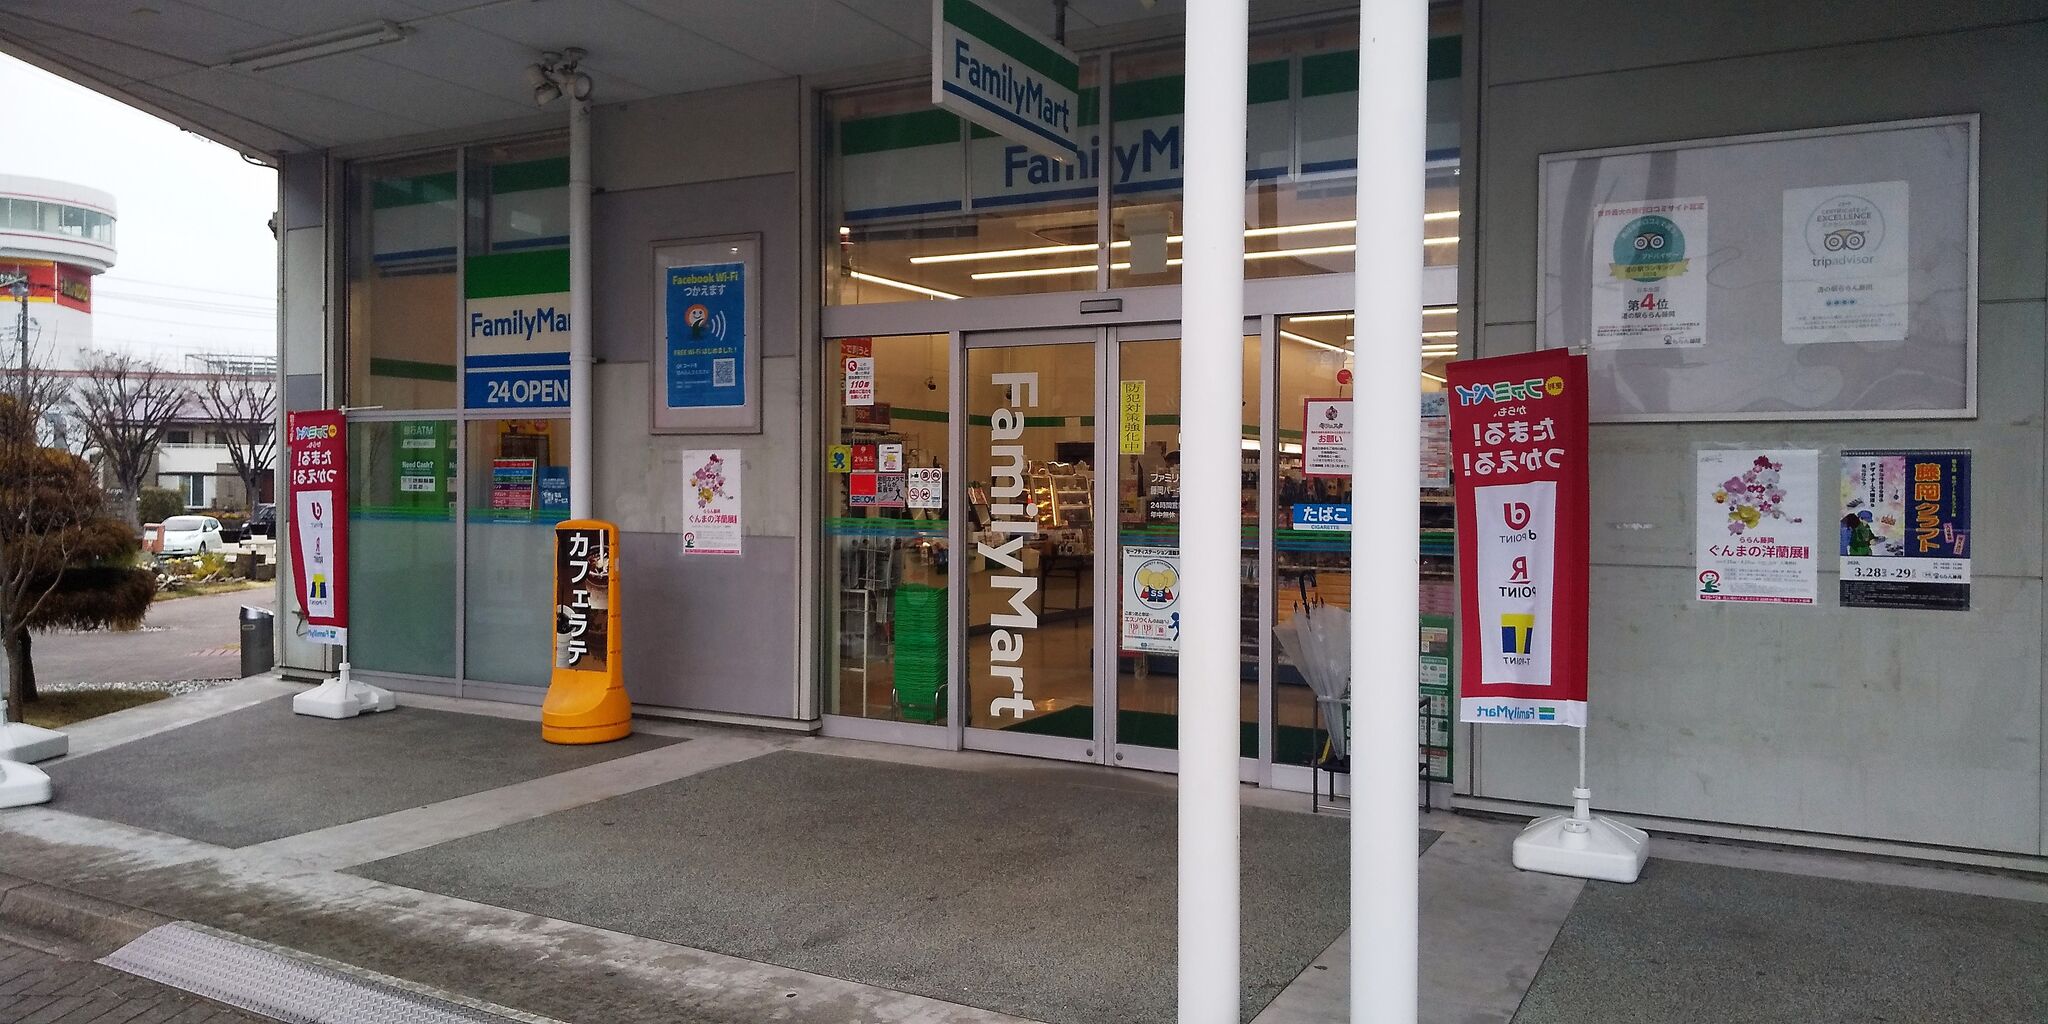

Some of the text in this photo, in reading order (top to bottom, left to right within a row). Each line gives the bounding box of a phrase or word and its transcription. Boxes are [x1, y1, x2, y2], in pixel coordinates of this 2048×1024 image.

[955, 38, 1069, 133] FamilyMart
[1004, 126, 1184, 187] FamiyM
[1816, 212, 1872, 223] EXCELLENCE
[1812, 254, 1874, 268] tripadvisor
[672, 271, 738, 285] Facebook Wi-Fi
[683, 284, 726, 296] つかえます
[1627, 293, 1669, 312] 第4位
[1124, 383, 1141, 452] 防犯対策強化中
[1318, 435, 1343, 443] お願い
[1150, 474, 1180, 483] ファミリ
[1150, 501, 1180, 510] 24時間営
[1303, 507, 1348, 522] たばこ
[977, 372, 1038, 718] FamilyMart
[567, 532, 590, 664] カフェラテ
